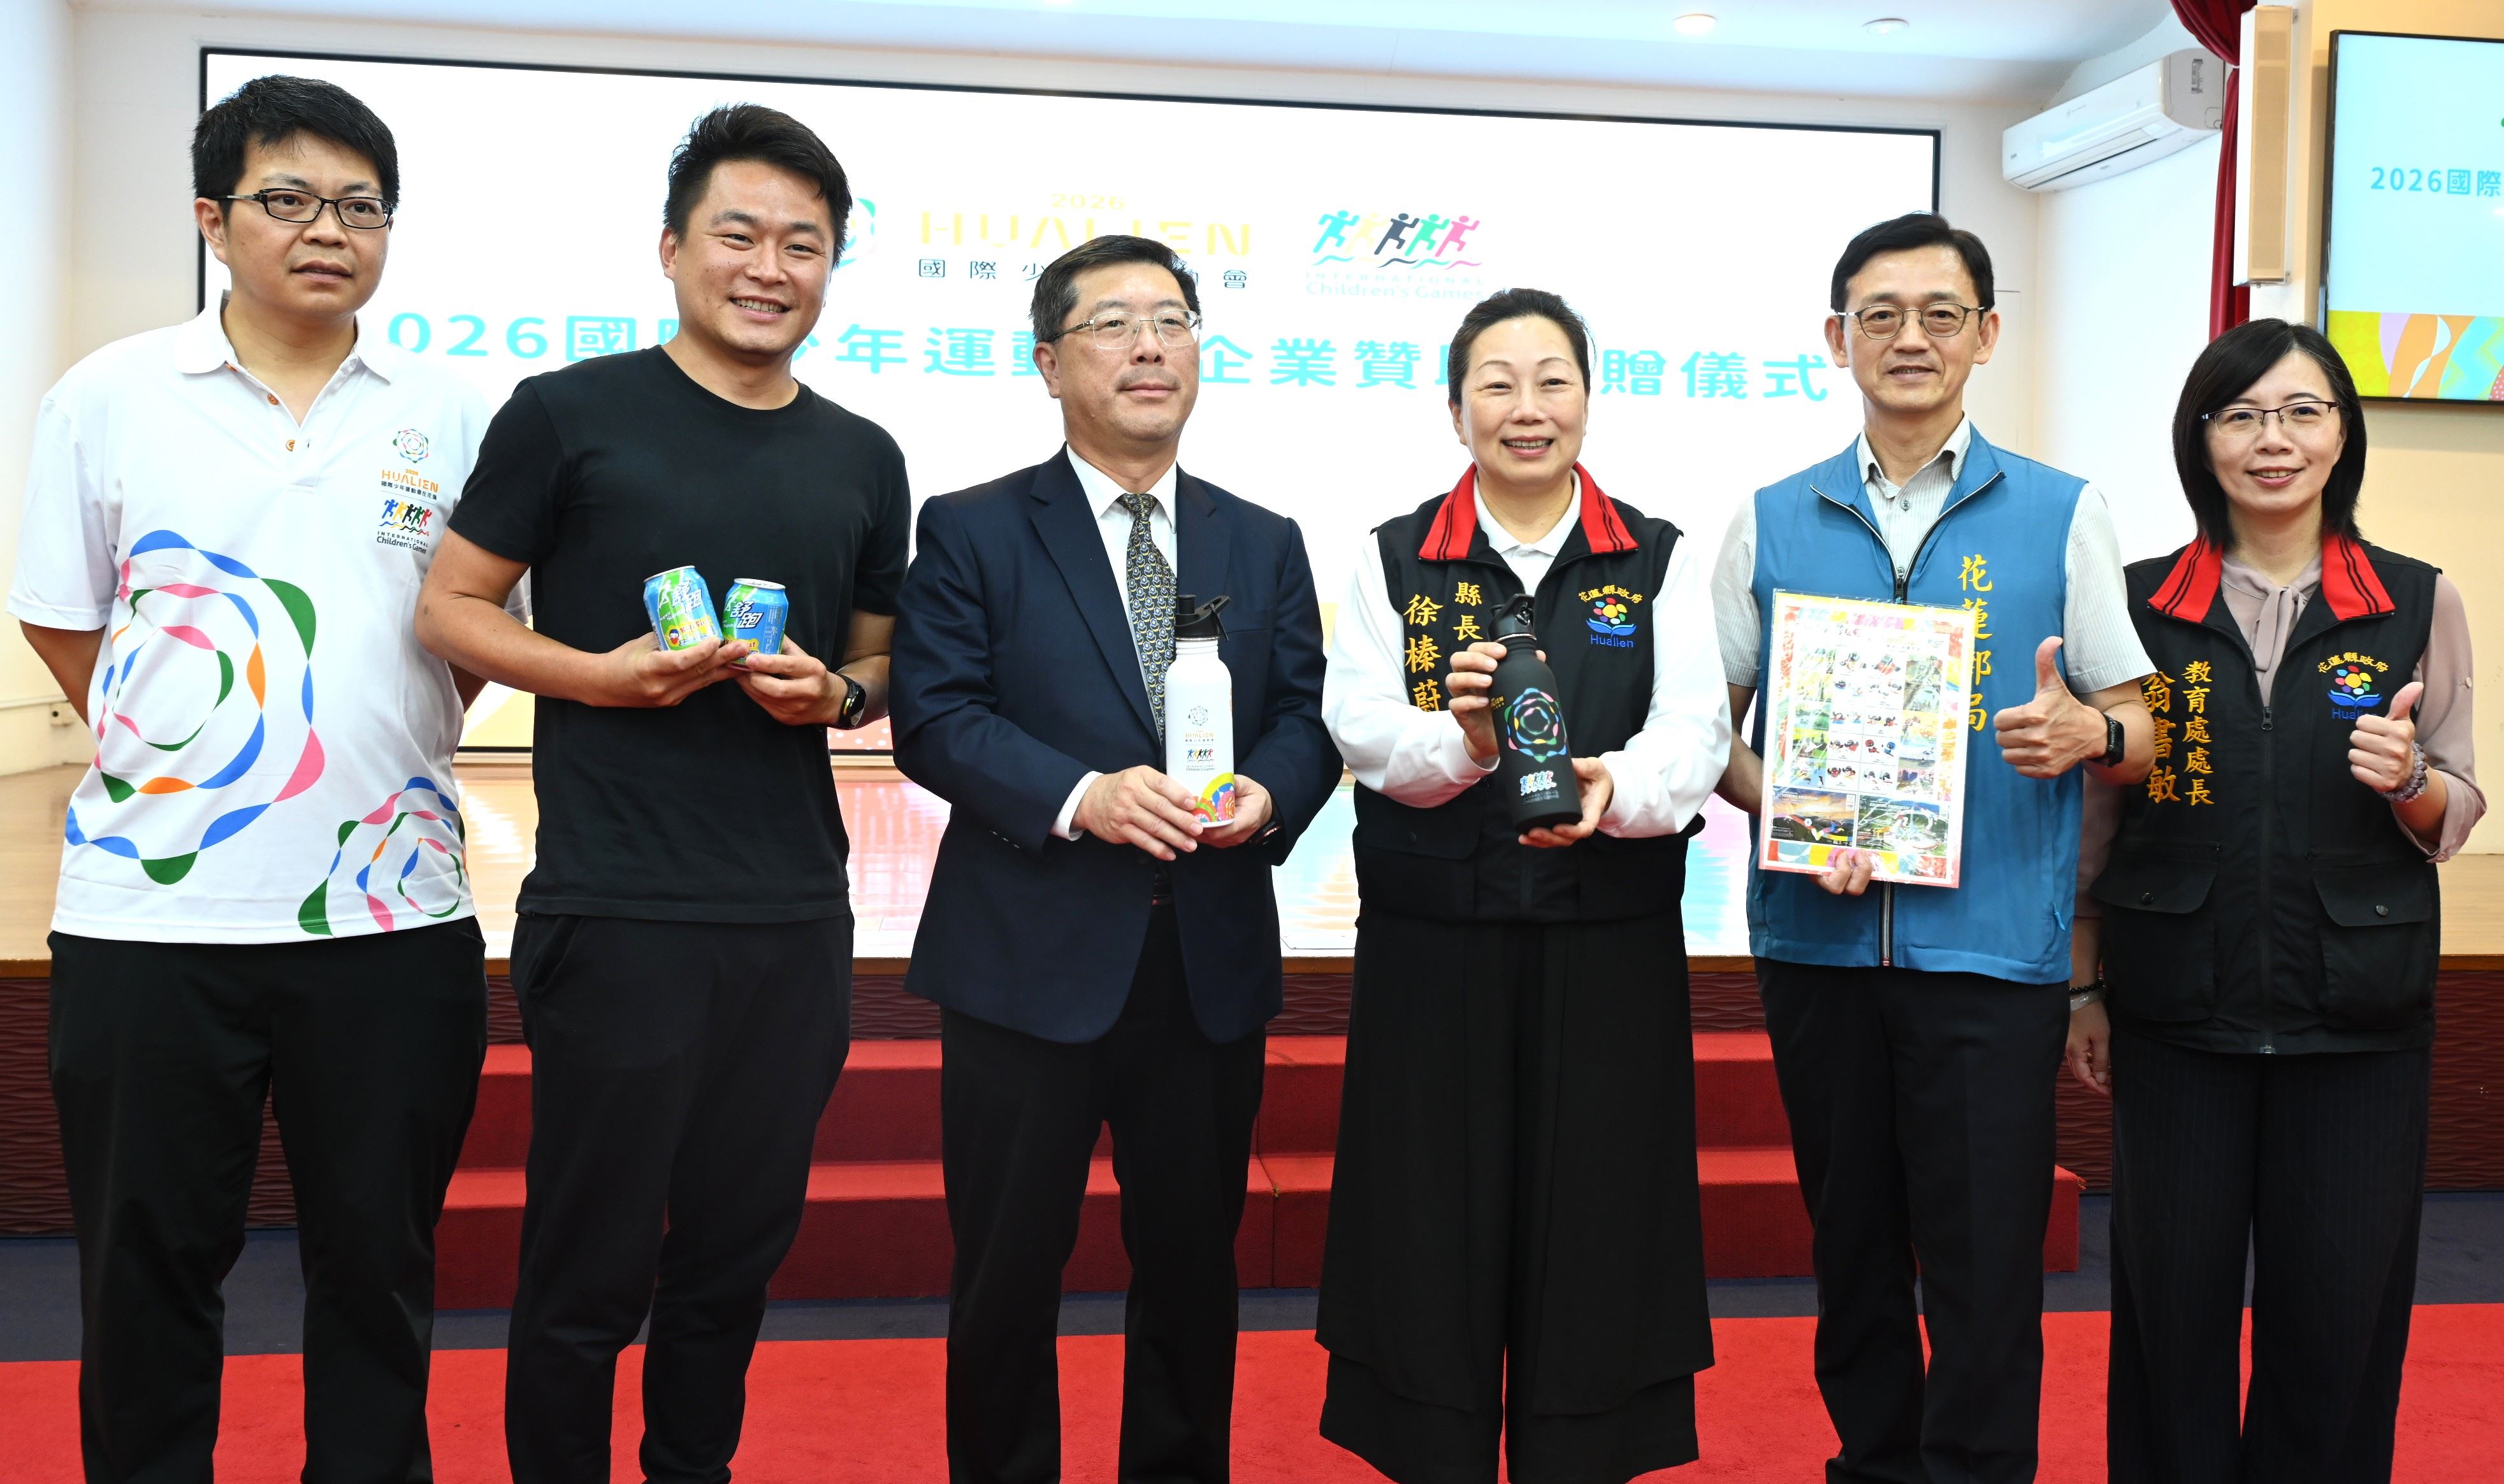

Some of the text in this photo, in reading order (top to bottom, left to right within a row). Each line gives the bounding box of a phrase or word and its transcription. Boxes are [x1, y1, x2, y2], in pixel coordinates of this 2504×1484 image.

[2370, 166, 2501, 197] 2026國際
[1050, 193, 1125, 210] 2026
[919, 258, 1247, 289] 國際少會
[1305, 272, 1484, 285] INTERNATIONAL
[1306, 282, 1484, 299] Children's Games
[382, 469, 438, 493] HUALIEN
[377, 531, 428, 547] INTERNATIONAL
[377, 536, 427, 554] Children's Games
[1578, 584, 1643, 603] 花蓮縣政府
[730, 601, 764, 629] 舒跑
[1453, 581, 1484, 641] 縣長
[1590, 634, 1634, 648] Hualien
[1403, 594, 1444, 712] 徐榛蔚
[2317, 652, 2389, 674] 花蓮縣政府
[2331, 708, 2377, 720] Hual
[2141, 671, 2182, 803] 翁書敏
[2181, 661, 2215, 806] 教育處處長
